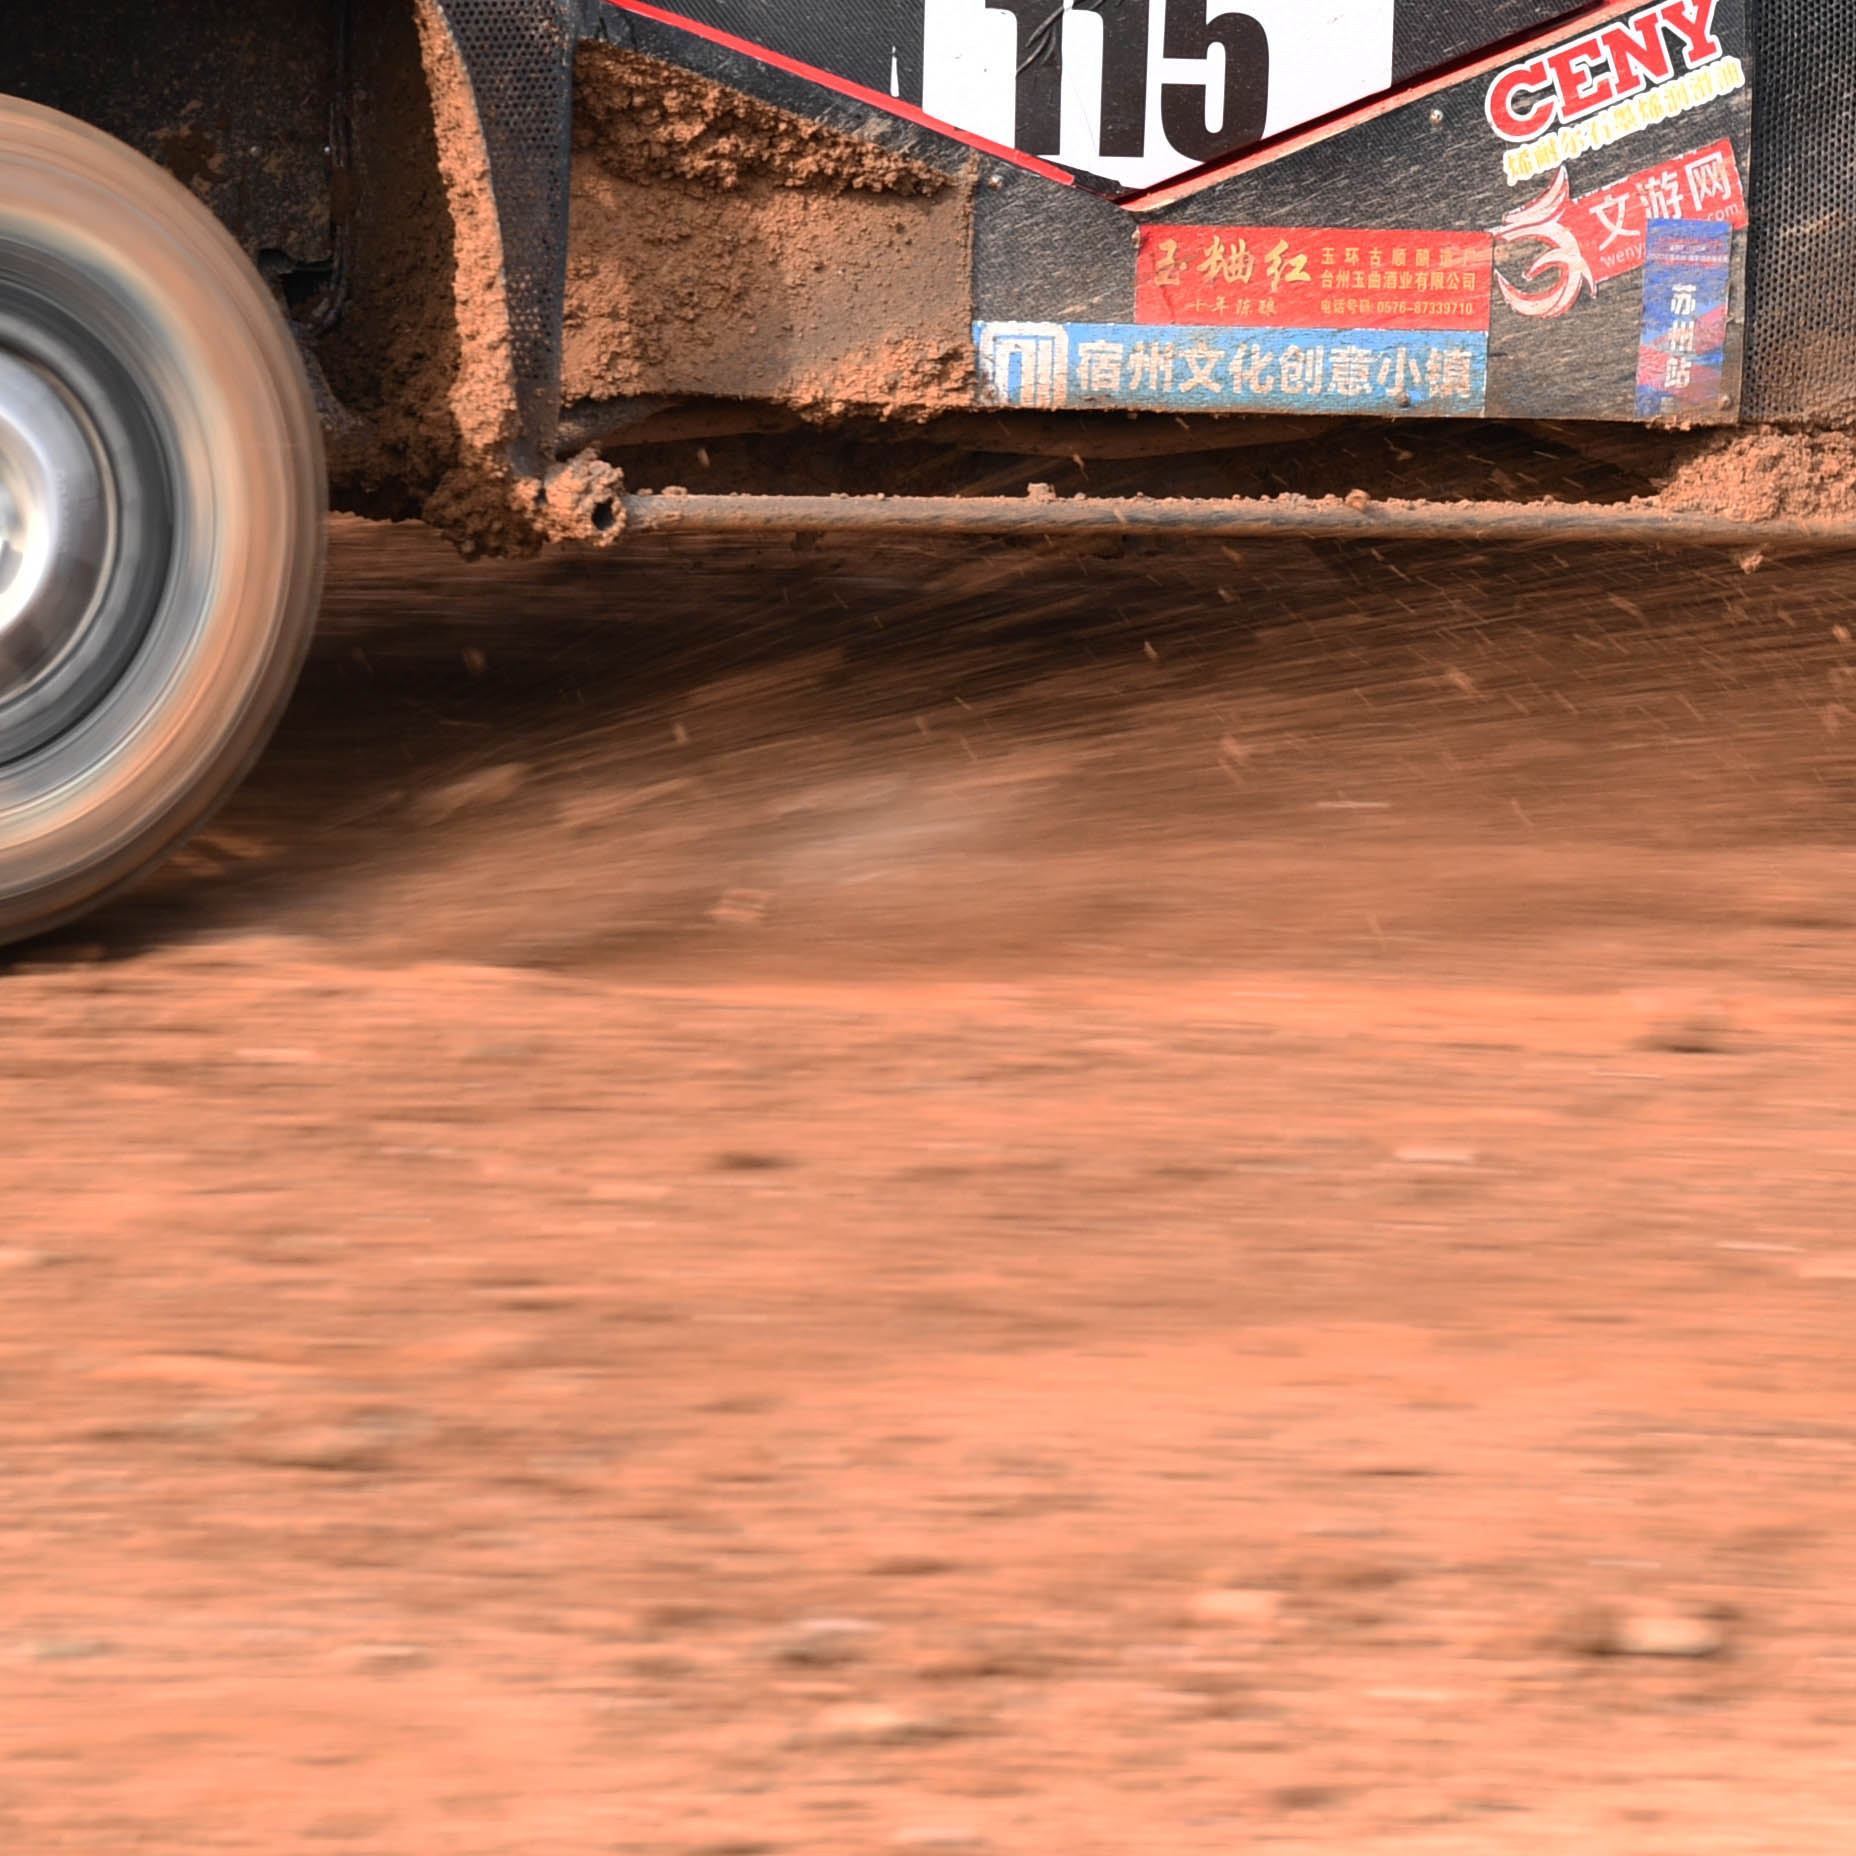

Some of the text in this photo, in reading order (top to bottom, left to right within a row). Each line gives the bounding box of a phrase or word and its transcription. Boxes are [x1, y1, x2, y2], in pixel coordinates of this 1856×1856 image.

[1589, 151, 1732, 252] 文游网
[1075, 339, 1473, 398] 宿州文化创意小镇
[1664, 283, 1697, 389] 苏州站
